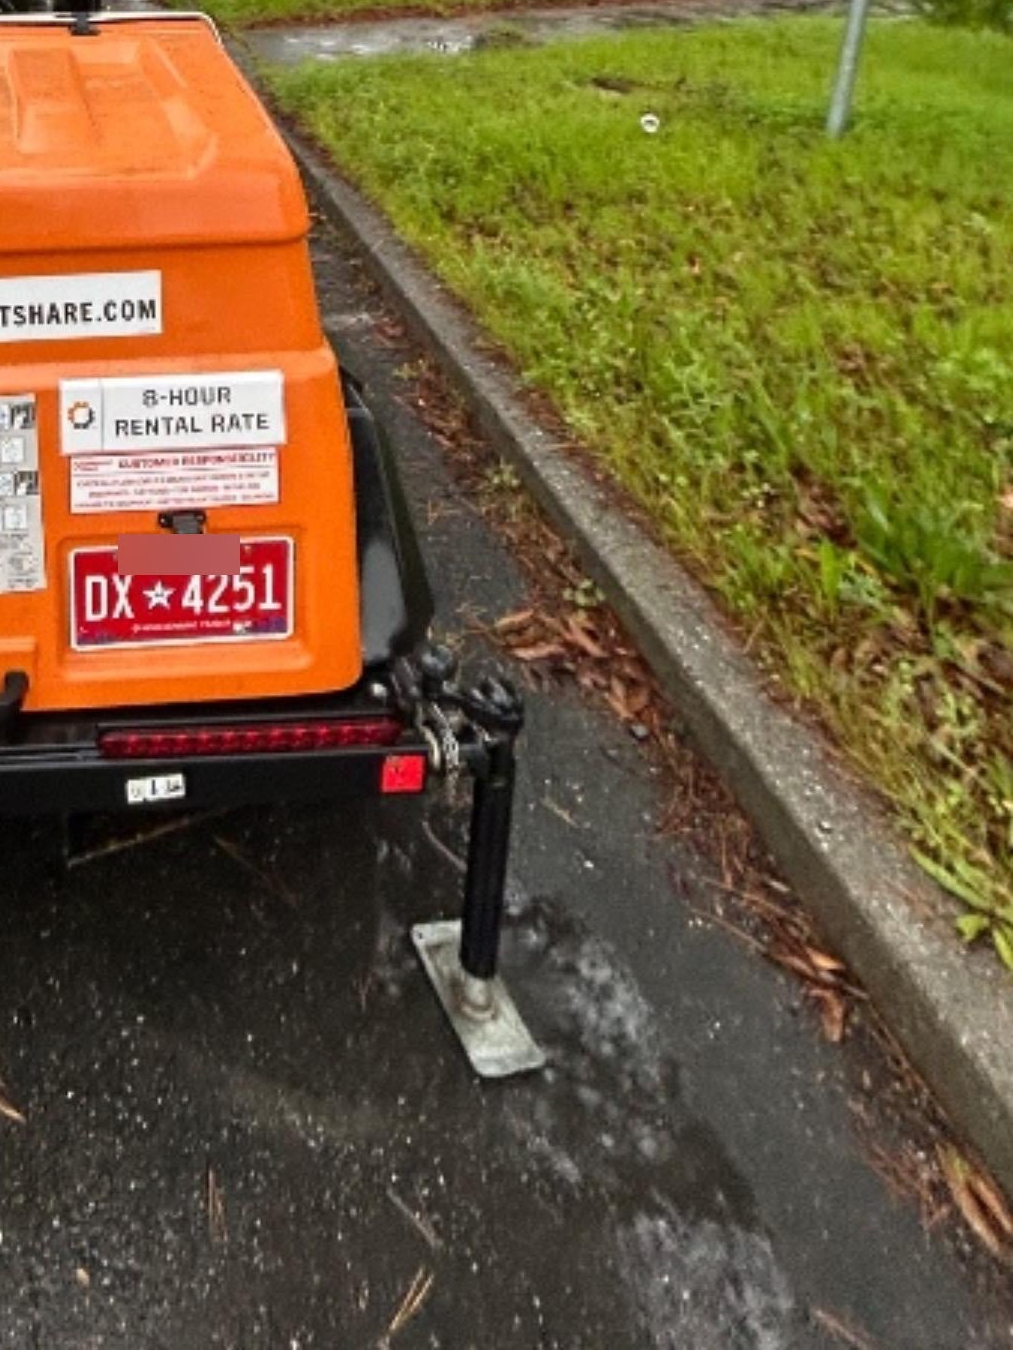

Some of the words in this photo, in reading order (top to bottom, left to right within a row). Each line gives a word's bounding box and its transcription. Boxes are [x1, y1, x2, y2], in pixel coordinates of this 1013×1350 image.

[142, 386, 232, 408] 8-HOUR
[115, 416, 203, 437] RENTAL
[211, 413, 270, 432] RATE
[84, 572, 135, 622] DX
[181, 563, 282, 615] 4251
